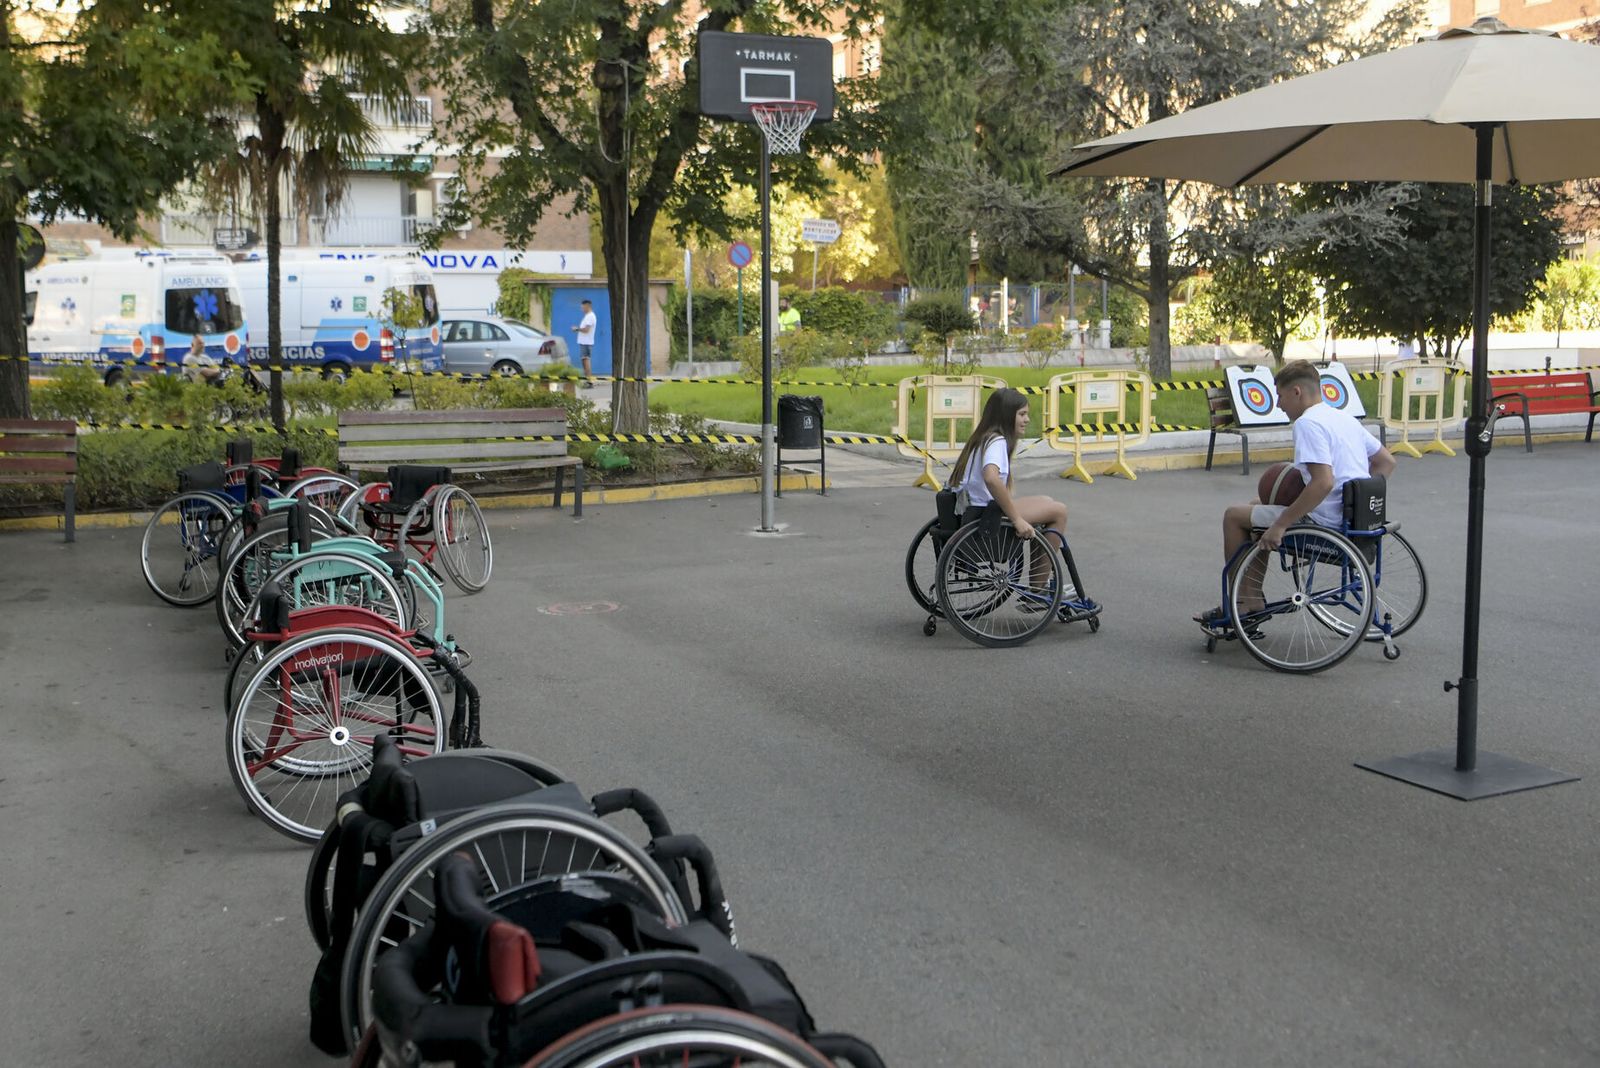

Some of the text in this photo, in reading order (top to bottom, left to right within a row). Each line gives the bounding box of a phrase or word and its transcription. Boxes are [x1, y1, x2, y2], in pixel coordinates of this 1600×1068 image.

[743, 49, 791, 62] TARMAK
[421, 255, 499, 269] NOVA
[1305, 543, 1339, 556] motivation
[294, 652, 344, 670] motivation
